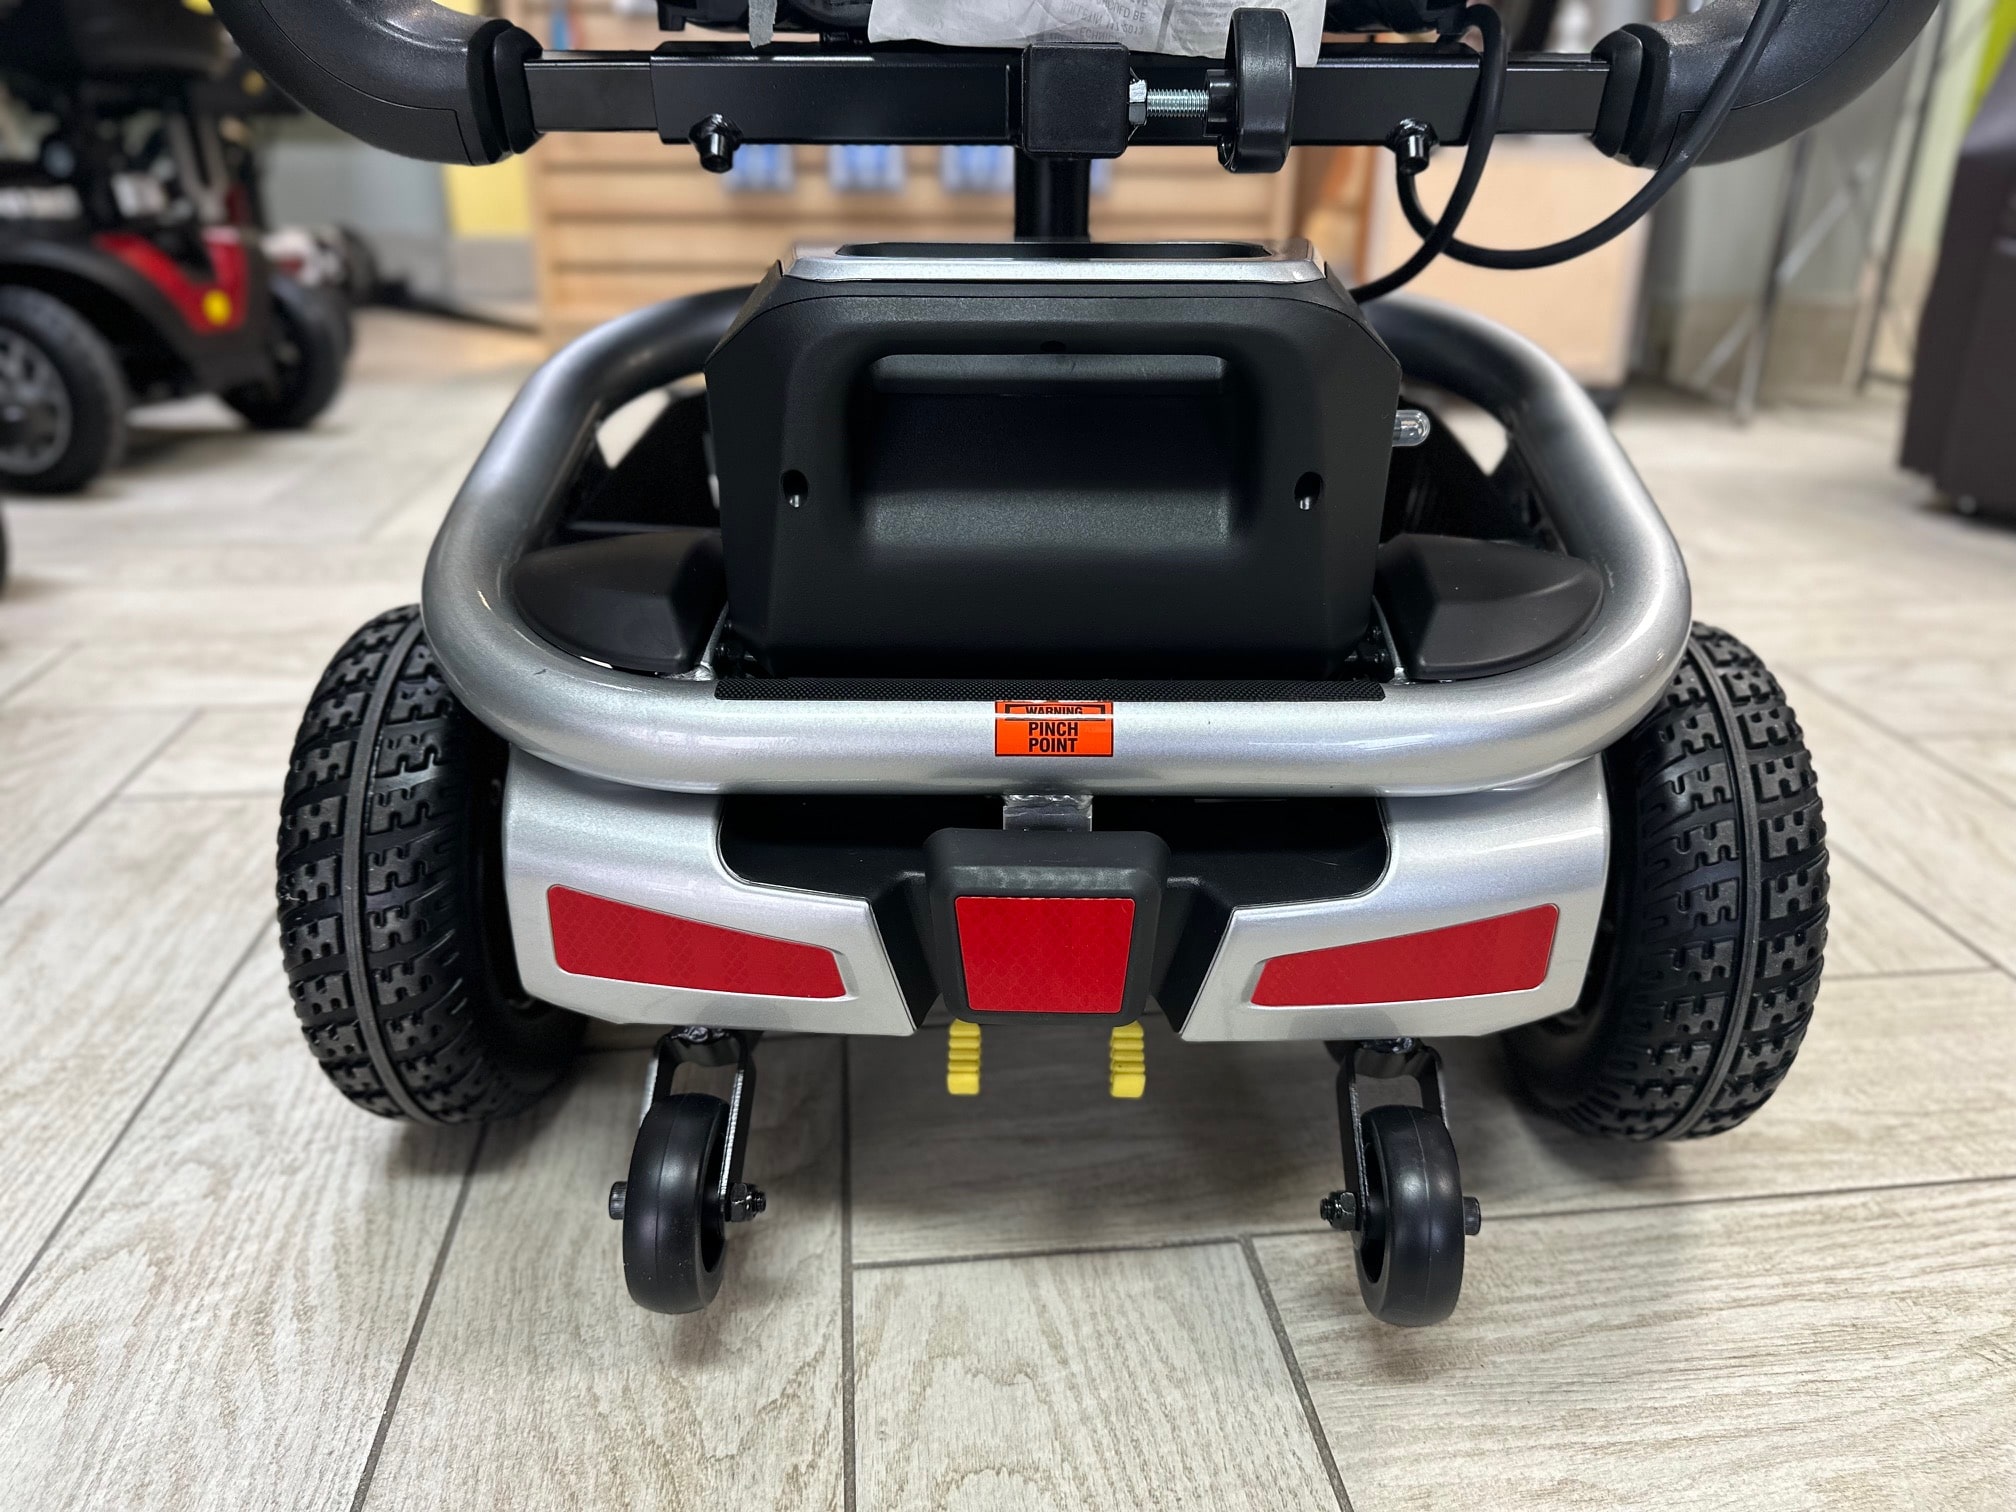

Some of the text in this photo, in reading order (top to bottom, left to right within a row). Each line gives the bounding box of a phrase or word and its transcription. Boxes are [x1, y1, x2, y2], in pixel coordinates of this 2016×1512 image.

[1025, 706, 1083, 715] WARNING
[1028, 721, 1078, 736] PINCH
[1028, 738, 1078, 753] POINT
